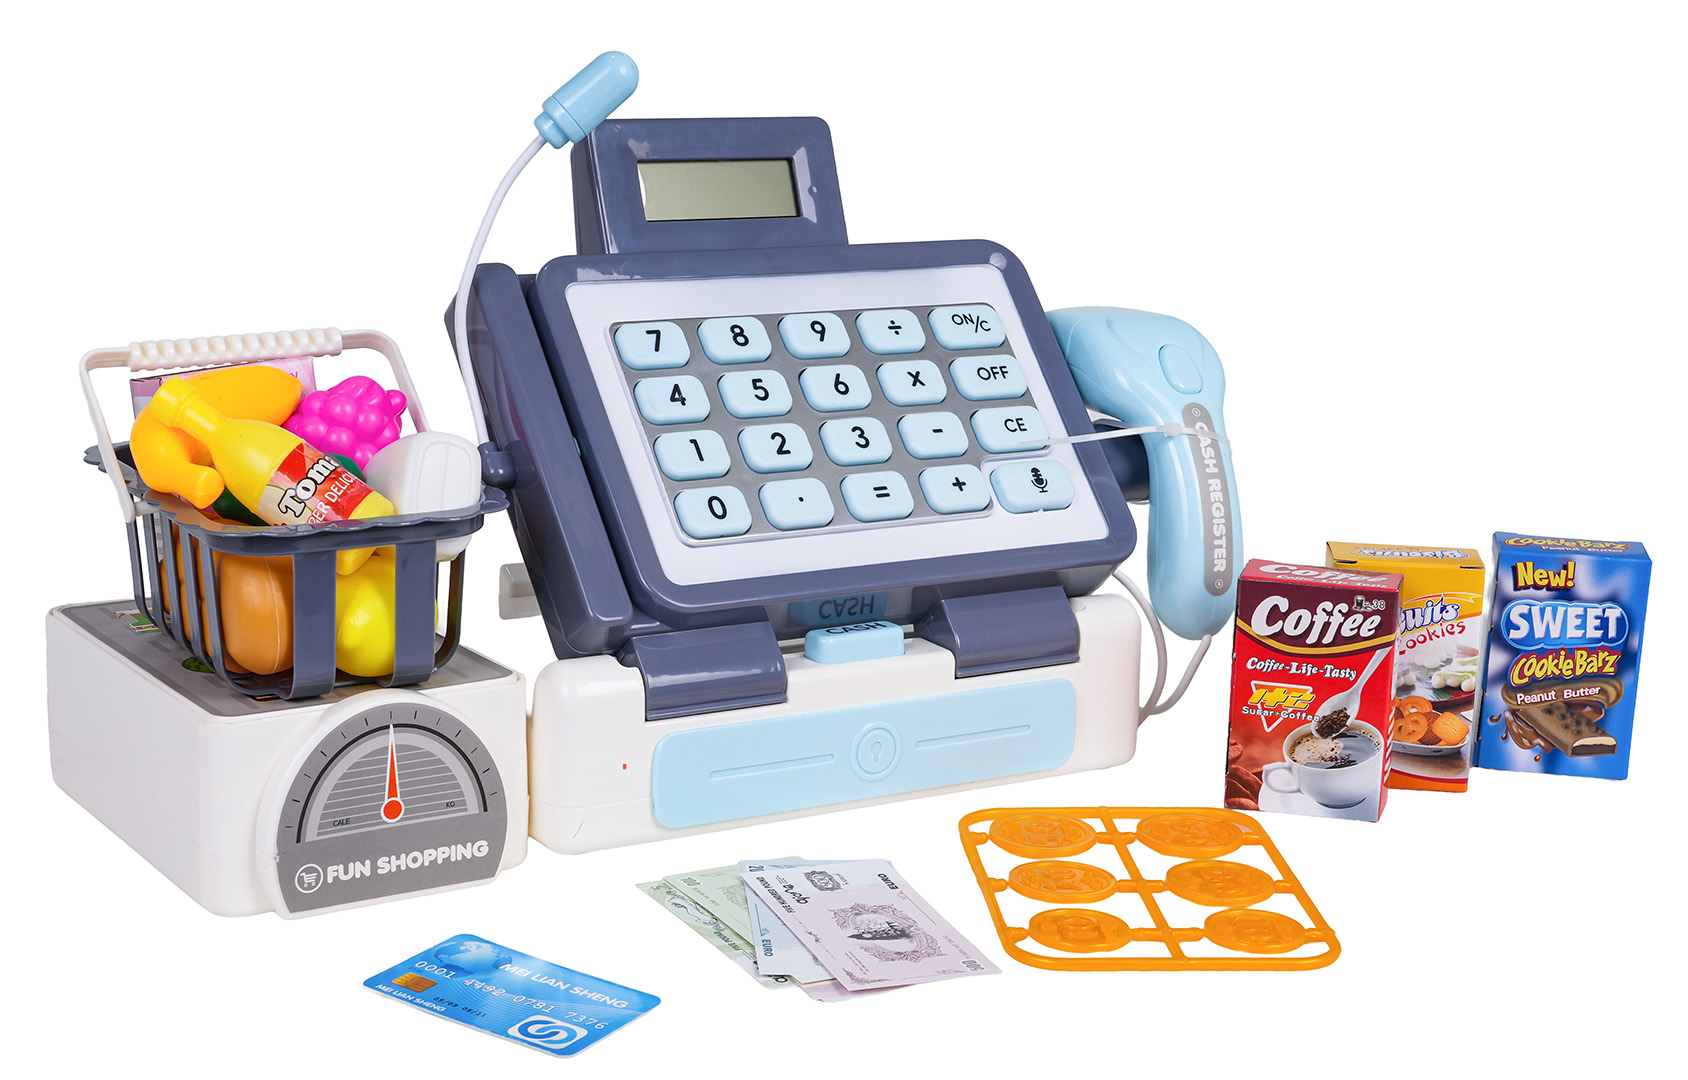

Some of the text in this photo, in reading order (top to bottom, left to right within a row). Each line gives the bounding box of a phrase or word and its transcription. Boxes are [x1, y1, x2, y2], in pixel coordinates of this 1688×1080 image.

[810, 321, 826, 342] 9
[951, 313, 992, 334] ON/C
[646, 329, 662, 352] 7
[729, 324, 750, 347] 8
[833, 372, 850, 395] 6
[976, 365, 1009, 382] OFF
[669, 384, 686, 406] 4
[752, 378, 770, 402] 5
[1003, 418, 1028, 433] CE
[770, 432, 791, 456] 2
[852, 426, 870, 449] 3
[689, 438, 706, 462] 1
[707, 495, 728, 520] 0
[1208, 478, 1226, 572] REGISTER
[1260, 564, 1388, 582] Coffee
[1515, 561, 1576, 588] New!
[1372, 600, 1386, 610] 38
[826, 622, 887, 634] CASH
[1251, 595, 1382, 645] Coffee
[1509, 604, 1622, 640] SWEET
[1399, 622, 1466, 656] ookies
[1516, 686, 1600, 705] Peanut Butter
[332, 818, 350, 827] CALE
[326, 840, 489, 884] FUN SHOPPING
[877, 873, 898, 890] EURO
[760, 938, 774, 958] EURO
[414, 960, 457, 980] 0001
[513, 995, 556, 1014] 0781
[565, 1012, 609, 1030] 7376
[499, 963, 630, 1009] MEI LIAN SHENG
[376, 984, 446, 1012] MEI LIAN SHENG
